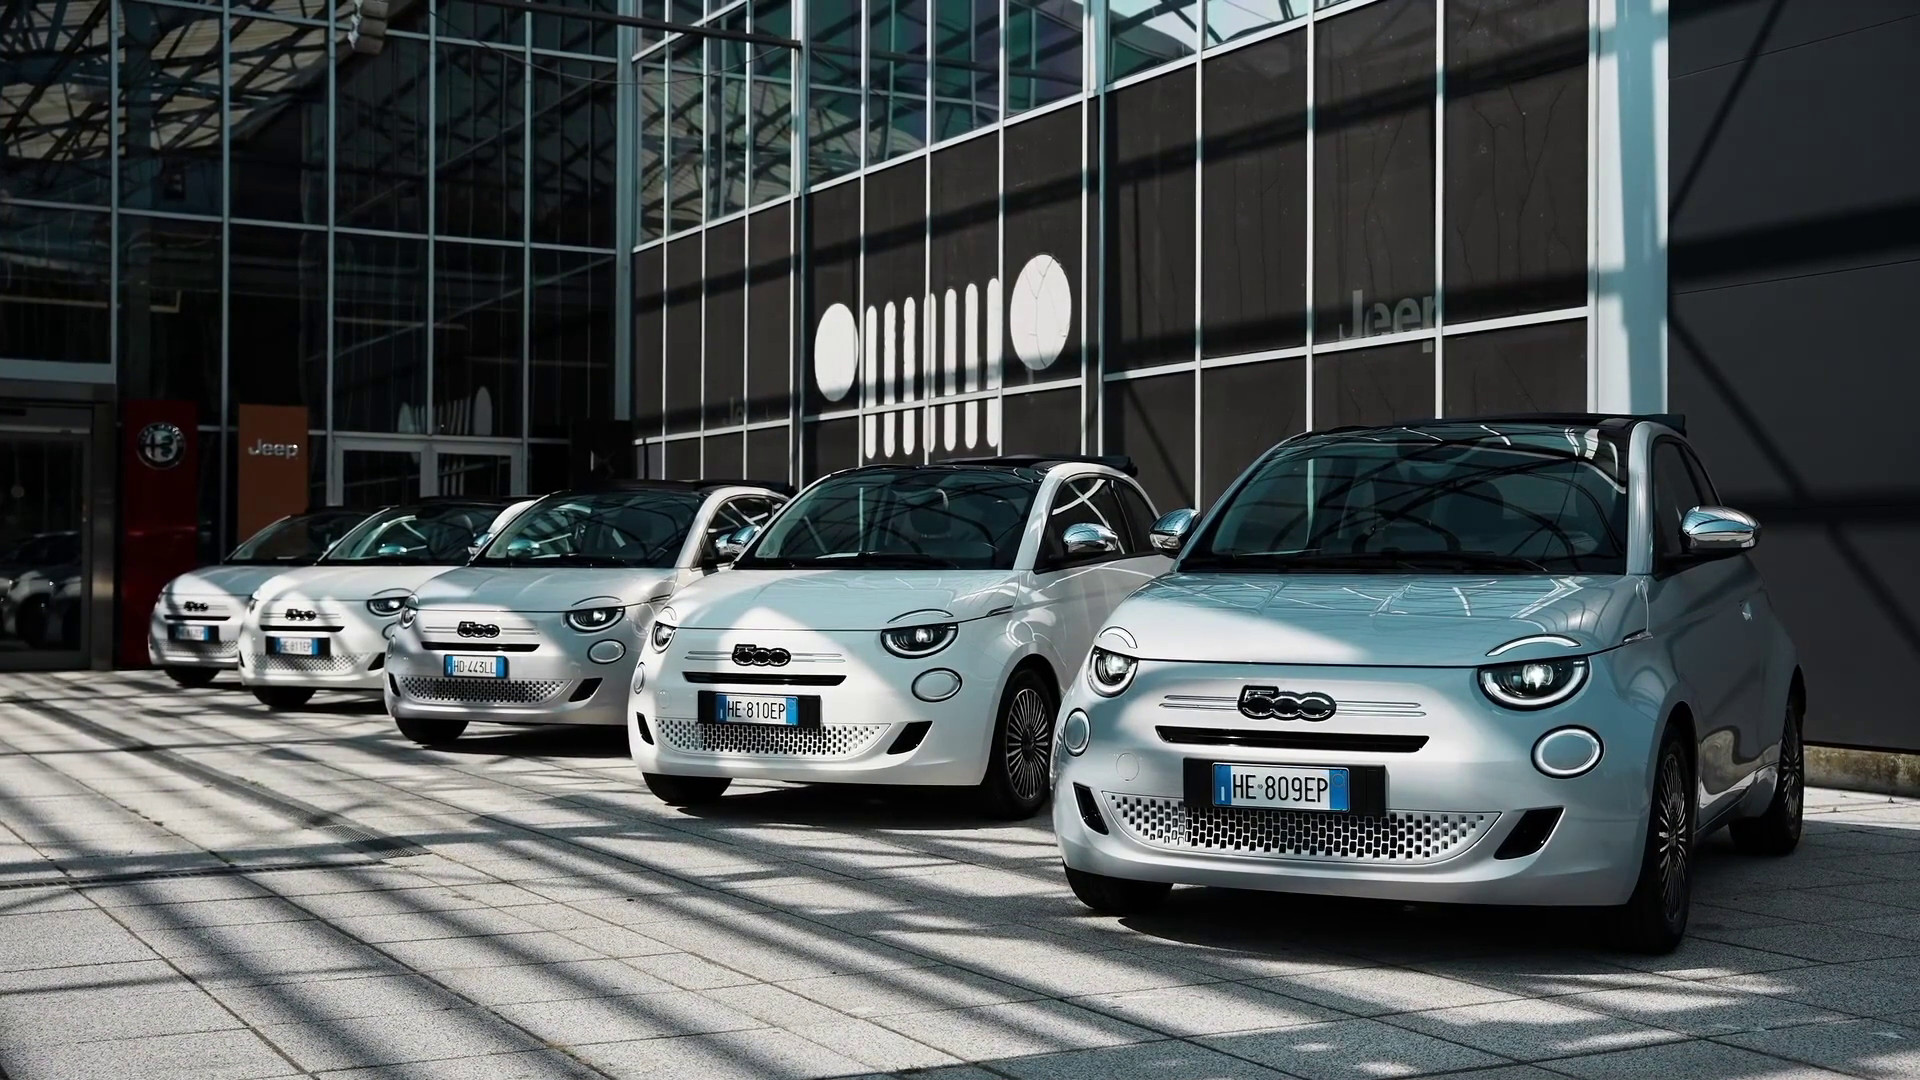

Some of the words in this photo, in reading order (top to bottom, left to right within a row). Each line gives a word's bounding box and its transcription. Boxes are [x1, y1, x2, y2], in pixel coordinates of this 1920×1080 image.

[248, 439, 298, 459] Jeep
[457, 621, 500, 638] 500
[732, 644, 791, 667] 500
[467, 660, 496, 674] 443LL
[727, 701, 742, 718] HE
[746, 701, 786, 720] 810EP
[1237, 685, 1337, 722] 500
[1232, 774, 1257, 799] HE
[1265, 775, 1329, 803] 809EP
